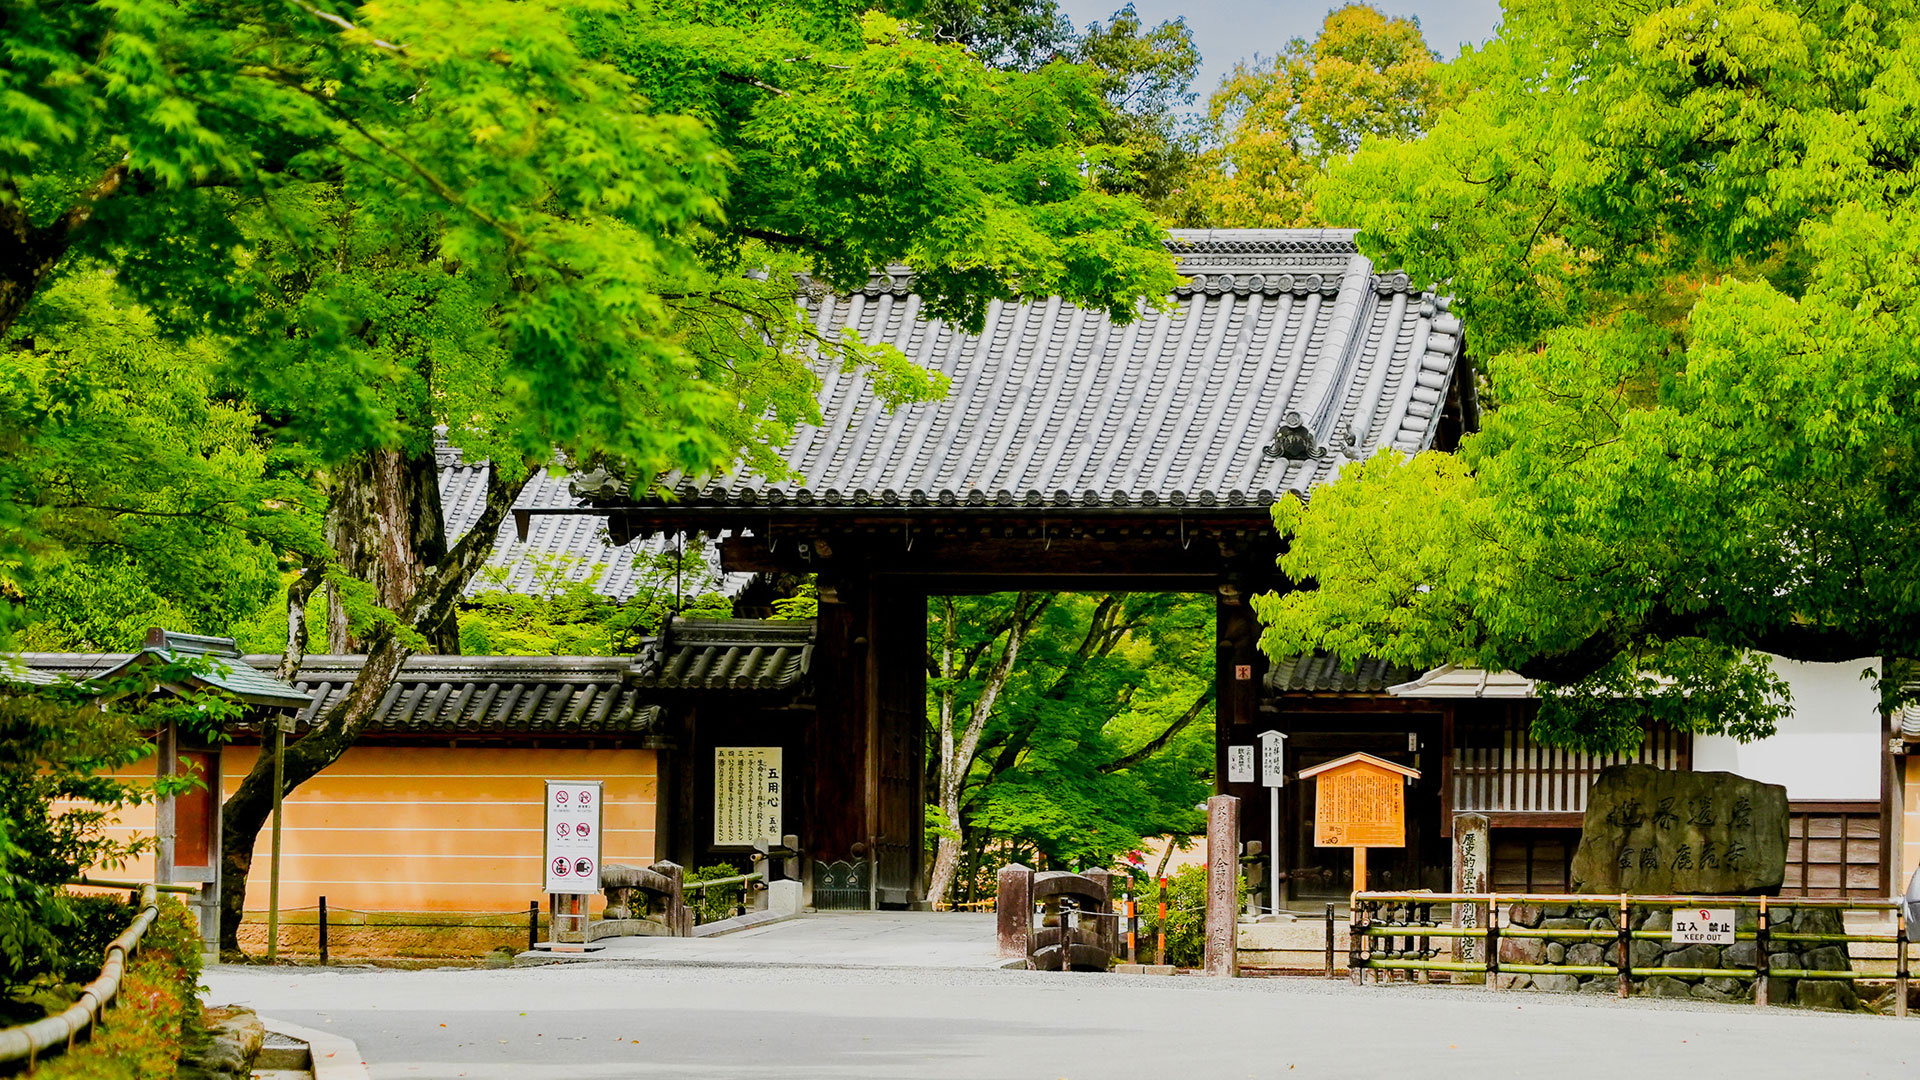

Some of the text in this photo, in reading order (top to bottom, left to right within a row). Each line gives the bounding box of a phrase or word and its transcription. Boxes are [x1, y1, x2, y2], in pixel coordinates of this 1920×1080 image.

[767, 768, 779, 808] 五用心
[1676, 922, 1730, 932] 立入 禁止
